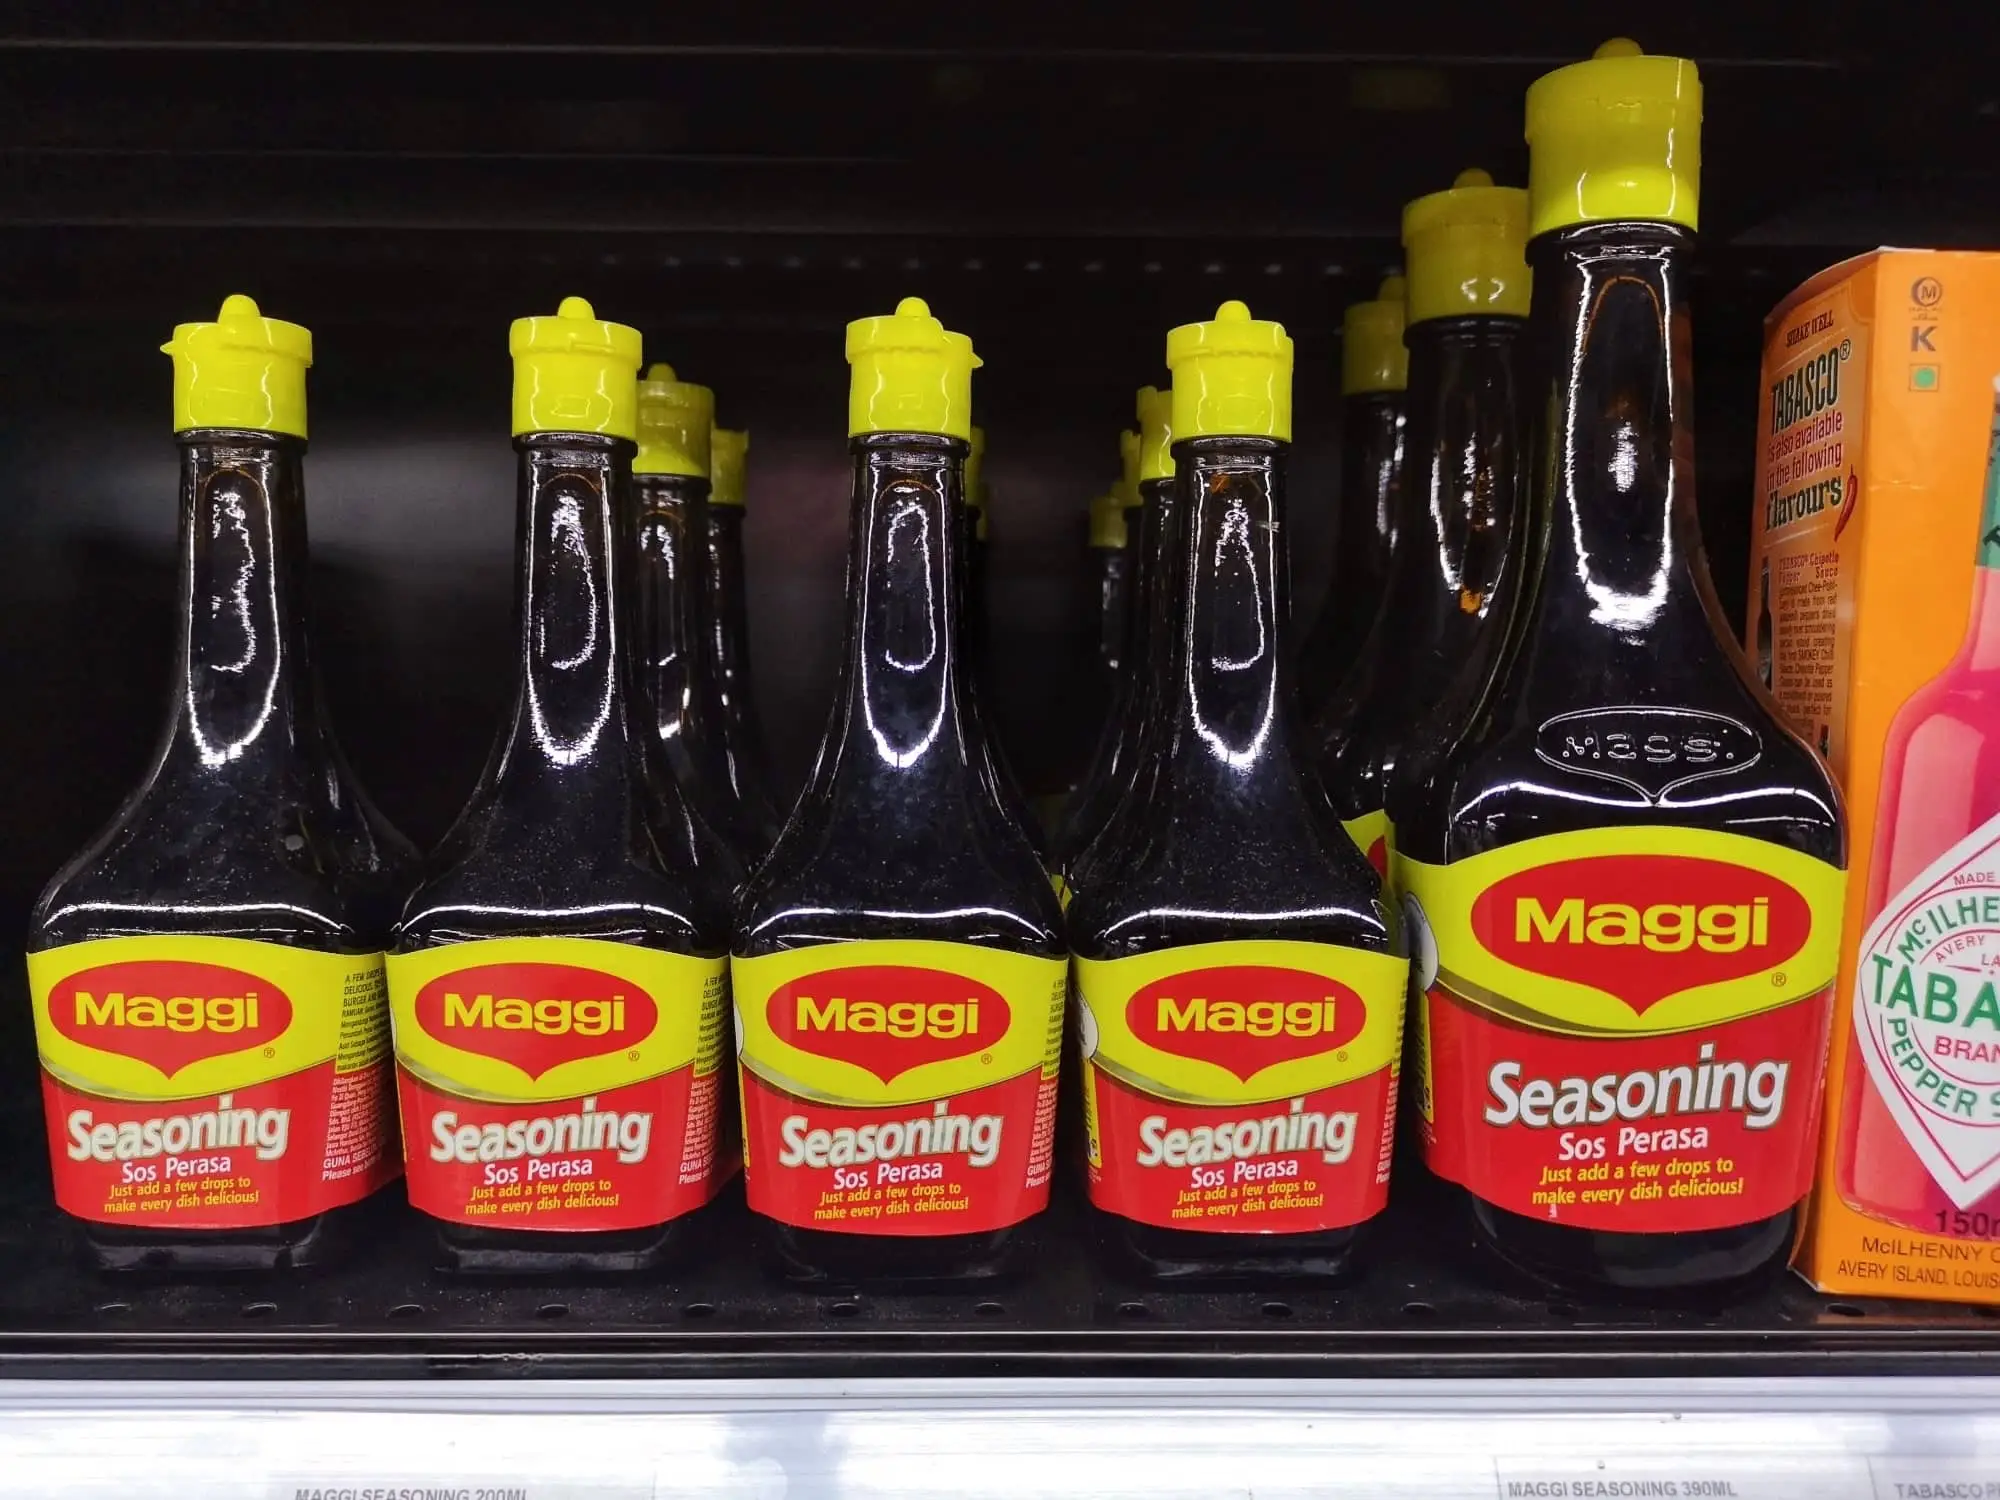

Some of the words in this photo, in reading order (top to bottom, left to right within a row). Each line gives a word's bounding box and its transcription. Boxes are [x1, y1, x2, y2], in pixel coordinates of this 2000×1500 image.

[1786, 320, 1810, 348] SHAKE
[1811, 310, 1834, 336] WELL
[1776, 434, 1793, 458] also
[1795, 409, 1842, 450] available
[1776, 463, 1790, 487] the
[1792, 442, 1842, 480] following
[1953, 871, 1996, 886] MADE
[1515, 897, 1769, 953] Maggi
[1935, 935, 1985, 963] AVERY
[1872, 953, 2000, 1032] TABA
[74, 992, 259, 1033] Maggi
[444, 993, 625, 1036] Maggi
[797, 997, 979, 1038] Maggi
[1157, 996, 1336, 1037] Maggi
[1888, 1017, 1978, 1118] PEPPER
[1484, 1042, 1789, 1130] Seasoning
[67, 1094, 291, 1161] Seasoning
[430, 1096, 653, 1164] Seasoning
[778, 1100, 1004, 1168] Seasoning
[1137, 1097, 1358, 1168] Seasoning
[1558, 1132, 1605, 1162] Sos
[1618, 1127, 1709, 1156] Perasa
[122, 1161, 157, 1184] Sos
[165, 1155, 232, 1179] Perasa
[322, 1168, 352, 1181] Please
[323, 1155, 351, 1169] GUNA
[484, 1164, 518, 1186] Sos
[527, 1159, 593, 1181] Perasa
[1190, 1167, 1225, 1189] Sos
[1233, 1159, 1298, 1183] Perasa
[1540, 1166, 1572, 1186] Just
[1577, 1161, 1609, 1181] add
[1614, 1167, 1624, 1180] a
[1630, 1159, 1659, 1179] few
[1665, 1158, 1711, 1180] drops
[1716, 1159, 1733, 1174] to
[109, 1184, 134, 1200] Just
[137, 1181, 160, 1196] add
[163, 1184, 171, 1193] a
[175, 1179, 198, 1193] few
[201, 1178, 235, 1194] drops
[238, 1177, 251, 1188] to
[471, 1185, 494, 1200] Just
[498, 1182, 521, 1197] add
[524, 1186, 532, 1196] a
[536, 1179, 559, 1194] few
[562, 1179, 594, 1194] drops
[599, 1178, 611, 1190] to
[833, 1168, 868, 1191] Sos
[877, 1163, 943, 1185] Perasa
[104, 1199, 136, 1213] make
[140, 1197, 173, 1213] every
[176, 1192, 200, 1208] dish
[204, 1190, 259, 1206] delicious!
[465, 1199, 497, 1215] make
[501, 1198, 532, 1215] every
[537, 1195, 560, 1210] dish
[564, 1193, 619, 1208] delicious!
[820, 1191, 844, 1206] Just
[847, 1187, 870, 1201] add
[874, 1190, 881, 1200] a
[886, 1184, 908, 1199] few
[912, 1184, 944, 1199] drops
[948, 1183, 961, 1194] to
[1177, 1189, 1201, 1205] Just
[1204, 1186, 1227, 1200] add
[1230, 1188, 1238, 1198] a
[1242, 1183, 1264, 1197] few
[1267, 1181, 1299, 1197] drops
[1303, 1180, 1316, 1191] to
[1532, 1185, 1576, 1206] make
[1581, 1185, 1624, 1206] every
[1630, 1182, 1663, 1202] dish
[1667, 1179, 1743, 1198] delicious!
[814, 1204, 846, 1220] make
[850, 1204, 881, 1219] every
[886, 1199, 910, 1214] dish
[914, 1197, 968, 1212] delicious!
[1172, 1203, 1204, 1219] make
[1207, 1202, 1238, 1217] every
[1242, 1197, 1265, 1213] dish
[1269, 1195, 1323, 1211] delicious!
[1861, 1236, 1983, 1262] McILHENNY
[1838, 1259, 1887, 1279] AVERY
[1508, 1481, 1568, 1497] MAGGI
[1573, 1480, 1676, 1497] SEASONING
[1683, 1480, 1737, 1497] 390ML
[1893, 1483, 1982, 1499] TABASCO
